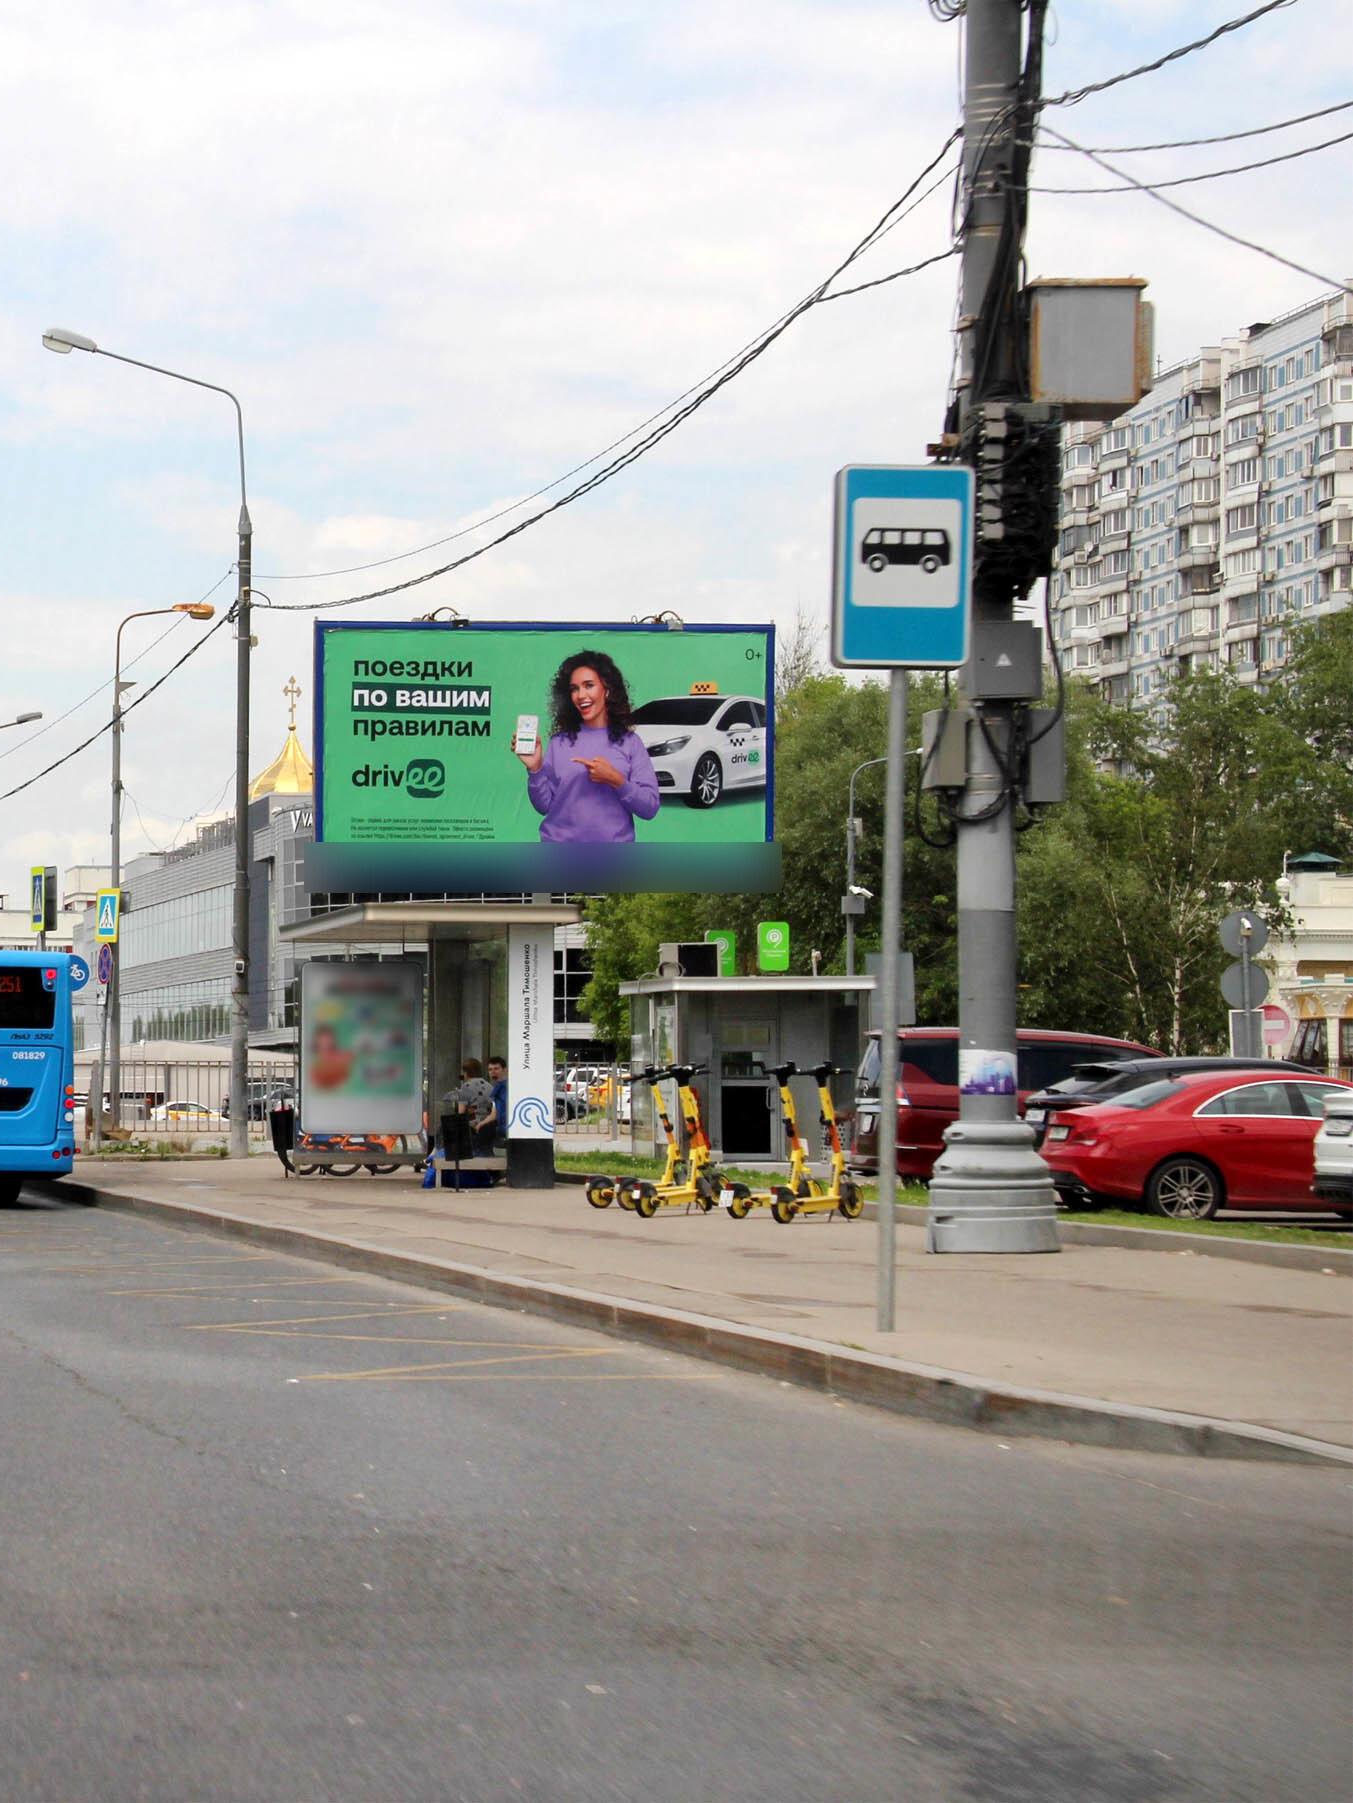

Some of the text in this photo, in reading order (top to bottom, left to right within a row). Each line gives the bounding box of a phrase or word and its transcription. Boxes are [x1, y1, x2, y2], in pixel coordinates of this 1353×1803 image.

[745, 648, 762, 660] 0+
[353, 660, 473, 681] поездки
[353, 689, 490, 708] по вашим
[353, 719, 491, 741] правилам
[351, 765, 445, 792] drivee
[522, 943, 532, 1070] Улица Маршала Тимошенко
[11, 1051, 46, 1060] 081829
